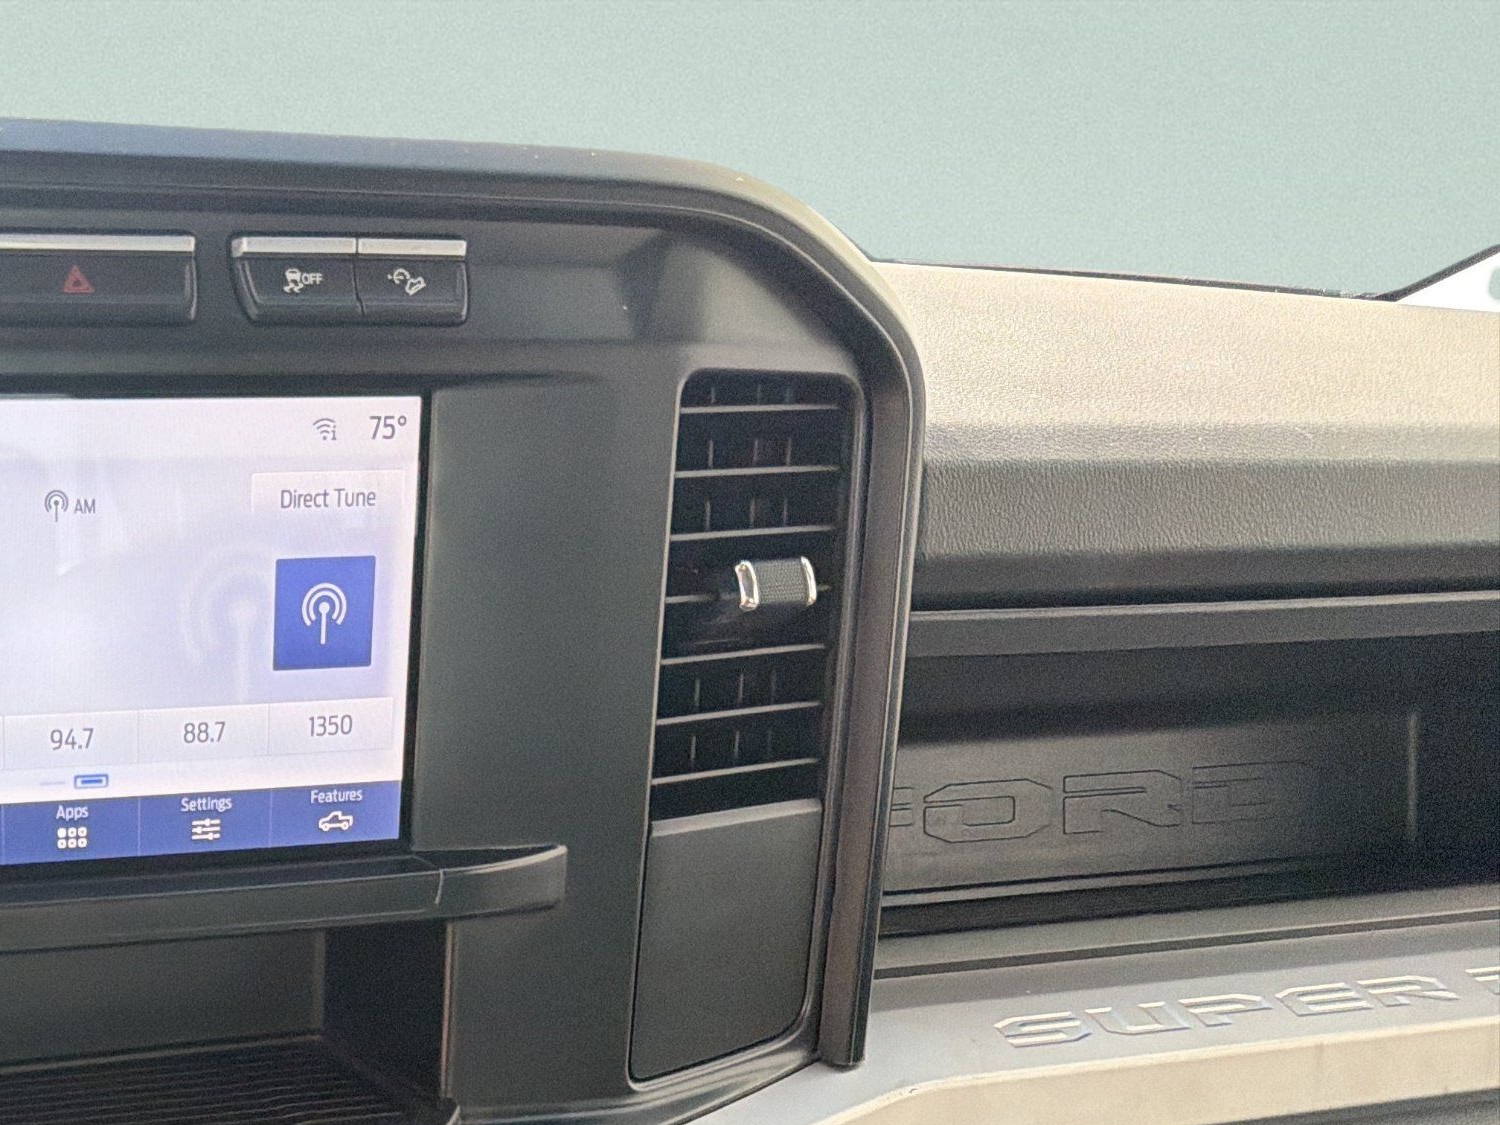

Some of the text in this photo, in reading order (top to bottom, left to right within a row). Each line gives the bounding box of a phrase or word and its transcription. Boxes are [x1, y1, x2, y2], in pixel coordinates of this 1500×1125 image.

[301, 272, 323, 285] OFF
[368, 415, 408, 440] 75°
[73, 498, 97, 515] AM
[279, 487, 376, 509] Direct Tune
[183, 721, 227, 744] 88.7
[308, 714, 354, 737] 1350
[50, 728, 95, 750] 94.7
[181, 797, 233, 812] Settings
[310, 790, 364, 804] Features
[56, 805, 89, 820] Apps
[994, 974, 1461, 1048] SUPER
